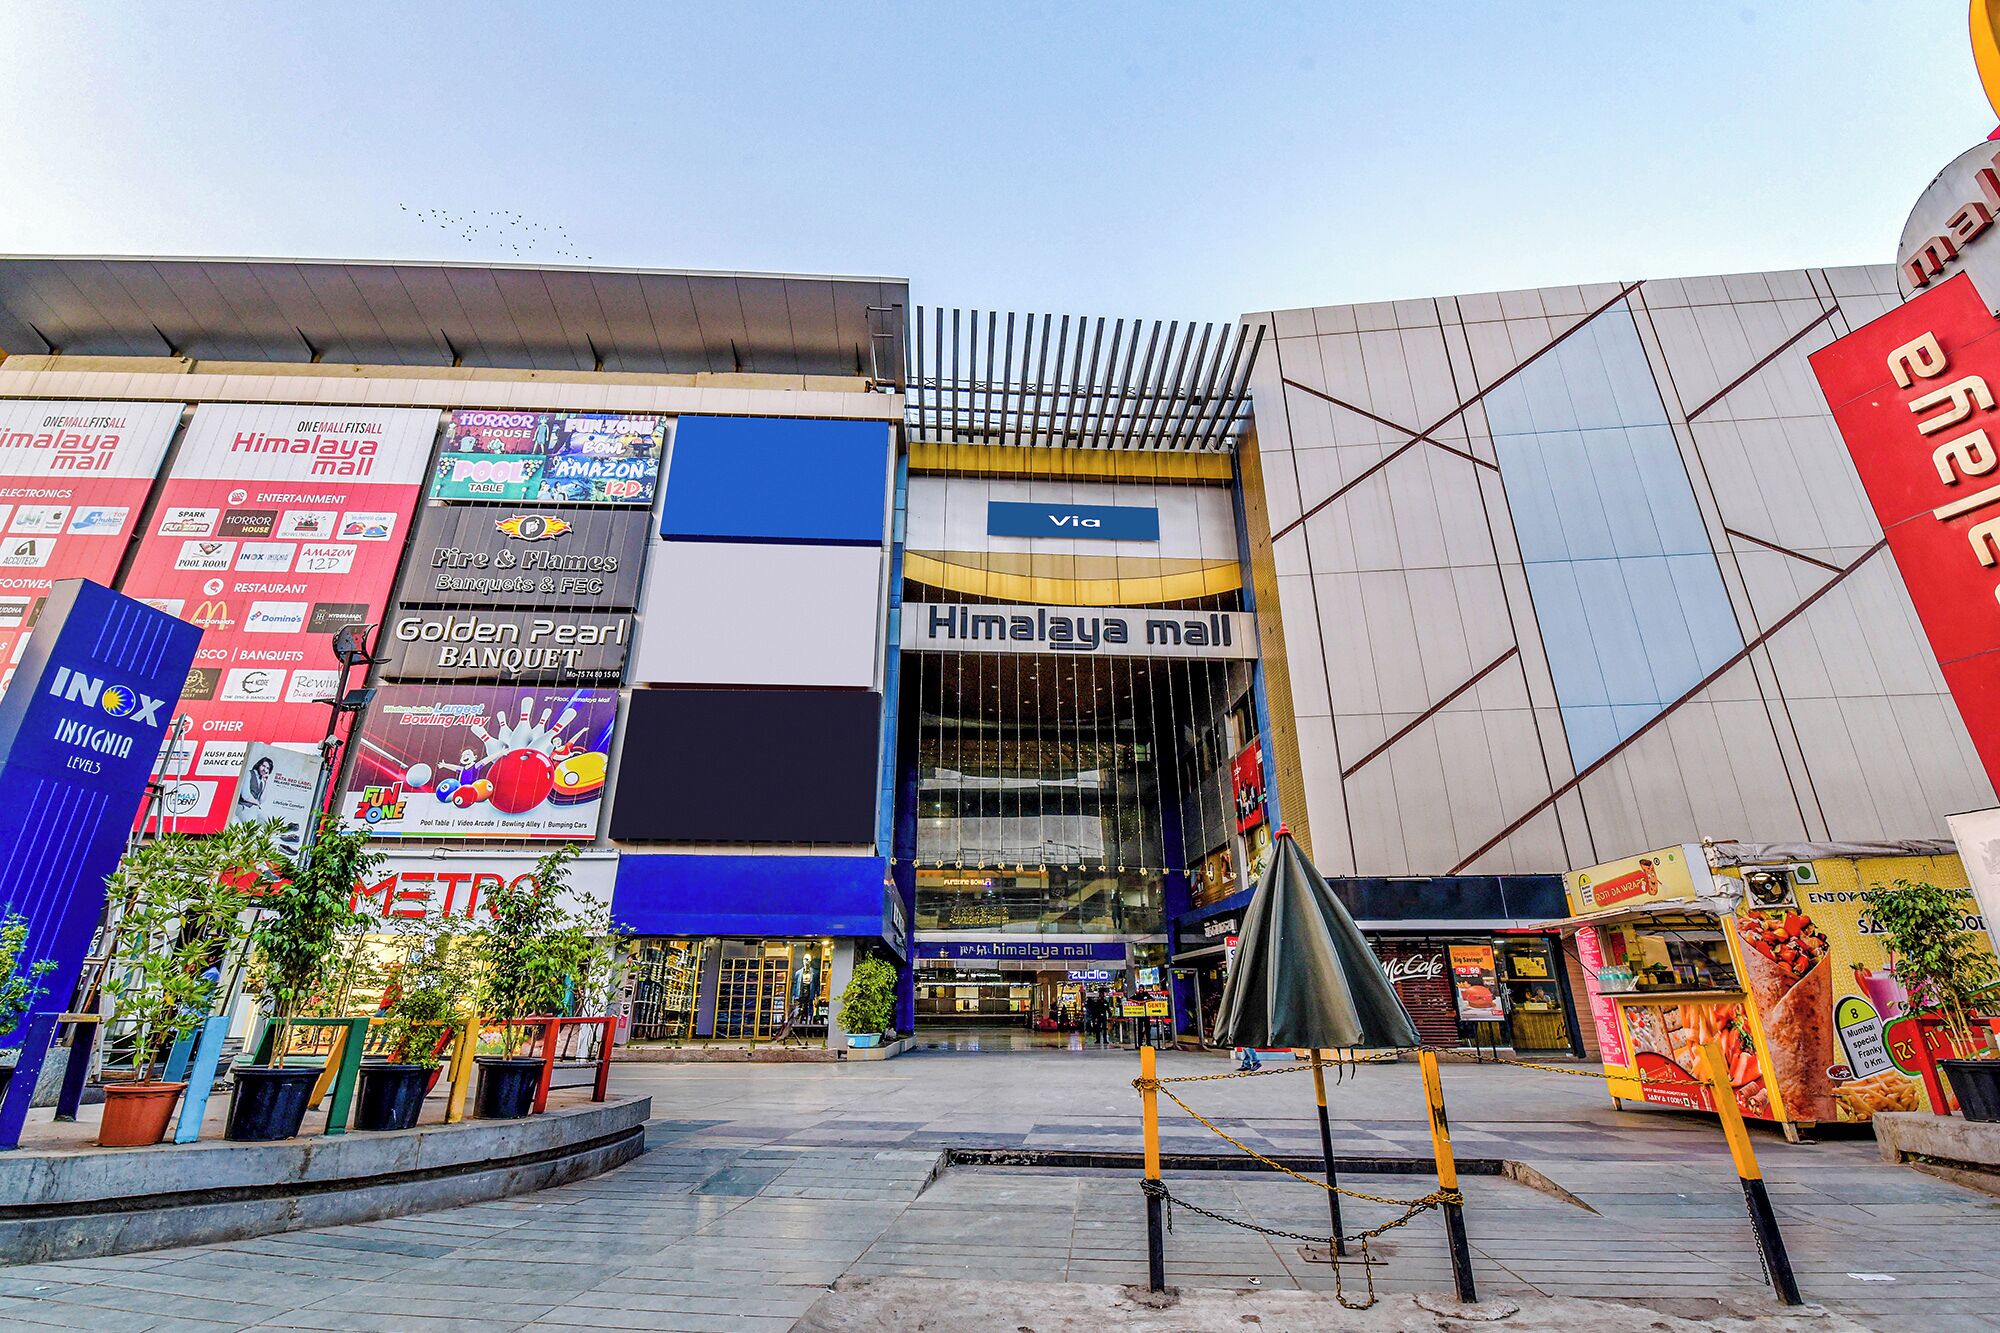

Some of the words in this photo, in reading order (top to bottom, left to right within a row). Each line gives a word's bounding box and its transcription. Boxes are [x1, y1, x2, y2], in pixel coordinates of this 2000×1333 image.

[459, 413, 534, 429] HORROR
[0, 428, 120, 454] imalaya
[482, 429, 532, 439] HOUSE
[231, 432, 379, 459] Himalaya
[583, 441, 627, 455] BOWL
[50, 451, 114, 470] mall
[311, 457, 374, 476] mall
[451, 460, 526, 483] POOL
[556, 462, 645, 479] AMAZON
[0, 488, 73, 499] ELECTRONICS
[468, 483, 504, 493] TABLE
[256, 493, 347, 504] ENTERTAINMENT
[226, 515, 272, 526] HORROR
[1048, 514, 1101, 528] Via
[241, 526, 270, 534] HOUSE
[303, 549, 354, 557] AMAZON
[431, 548, 490, 568] Fire
[494, 549, 516, 568] &
[520, 550, 618, 571] Flames
[2, 556, 39, 566] ACCUTECH
[178, 559, 200, 567] POOL
[202, 560, 227, 568] ROOM
[306, 558, 340, 570] 12D
[0, 579, 52, 589] FOOTWEA
[234, 583, 307, 594] RESTAURANT
[435, 574, 535, 594] Banquets
[538, 577, 555, 593] &
[560, 578, 603, 593] FEC
[261, 614, 302, 623] Domino's
[395, 616, 519, 643] Golden
[530, 618, 625, 645] Pearl
[928, 605, 1129, 651] Himalaya
[1146, 613, 1232, 647] mall
[194, 649, 228, 659] ISCO
[239, 650, 303, 661] BANQUETS
[437, 647, 582, 673] BANQUET
[50, 666, 166, 728] INOX
[432, 703, 485, 716] Largest
[202, 720, 244, 731] OTHER
[400, 714, 455, 727] Bowling
[454, 714, 490, 727] Alley
[54, 718, 134, 759] INSIGNIA
[362, 782, 404, 807] FUN
[354, 801, 407, 824] ZONE
[501, 821, 525, 829] Bowling
[1809, 891, 1858, 904] ENJOY
[992, 943, 1060, 959] himalaya
[1063, 943, 1093, 956] mall
[1850, 1008, 1859, 1019] 8
[1846, 1023, 1875, 1038] Mumbai
[1853, 1033, 1879, 1049] special
[1858, 1045, 1882, 1059] Franky
[1870, 1058, 1886, 1067] Km.
